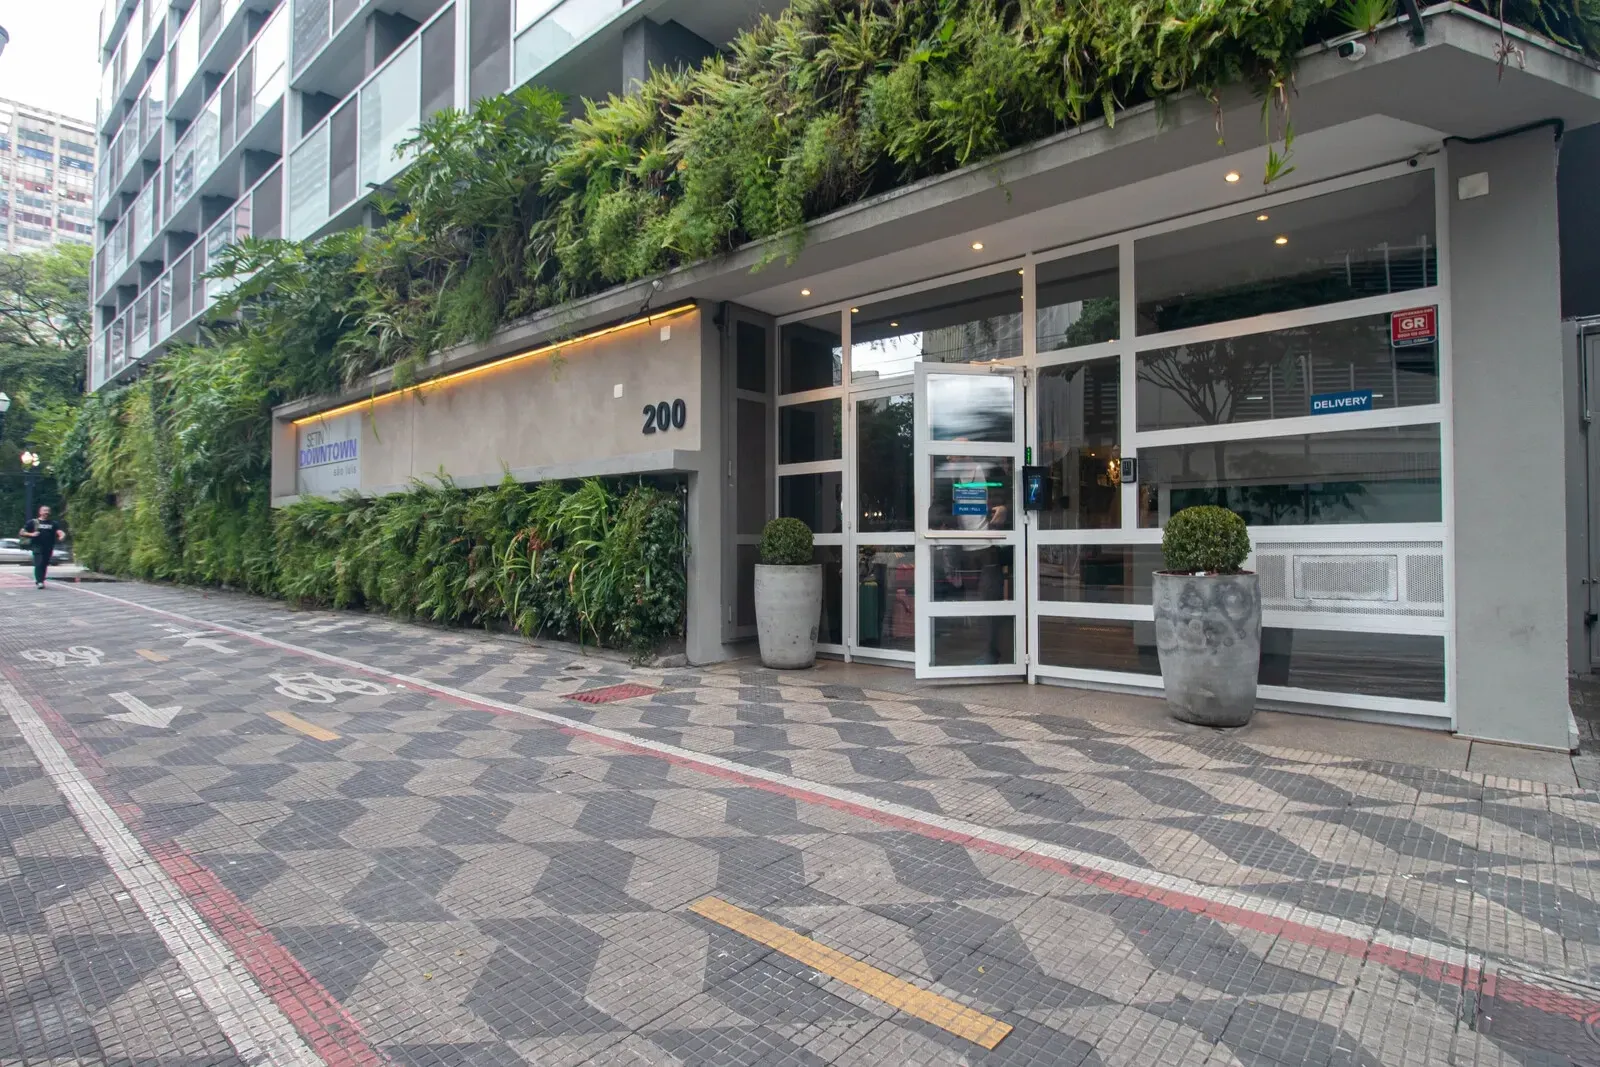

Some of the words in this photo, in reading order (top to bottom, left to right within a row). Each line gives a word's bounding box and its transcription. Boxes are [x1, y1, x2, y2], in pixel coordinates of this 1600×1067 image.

[1401, 317, 1425, 330] GR
[1313, 396, 1368, 410] DELIVERY
[642, 398, 686, 435] 200
[299, 438, 357, 467] DOWNTOWN
